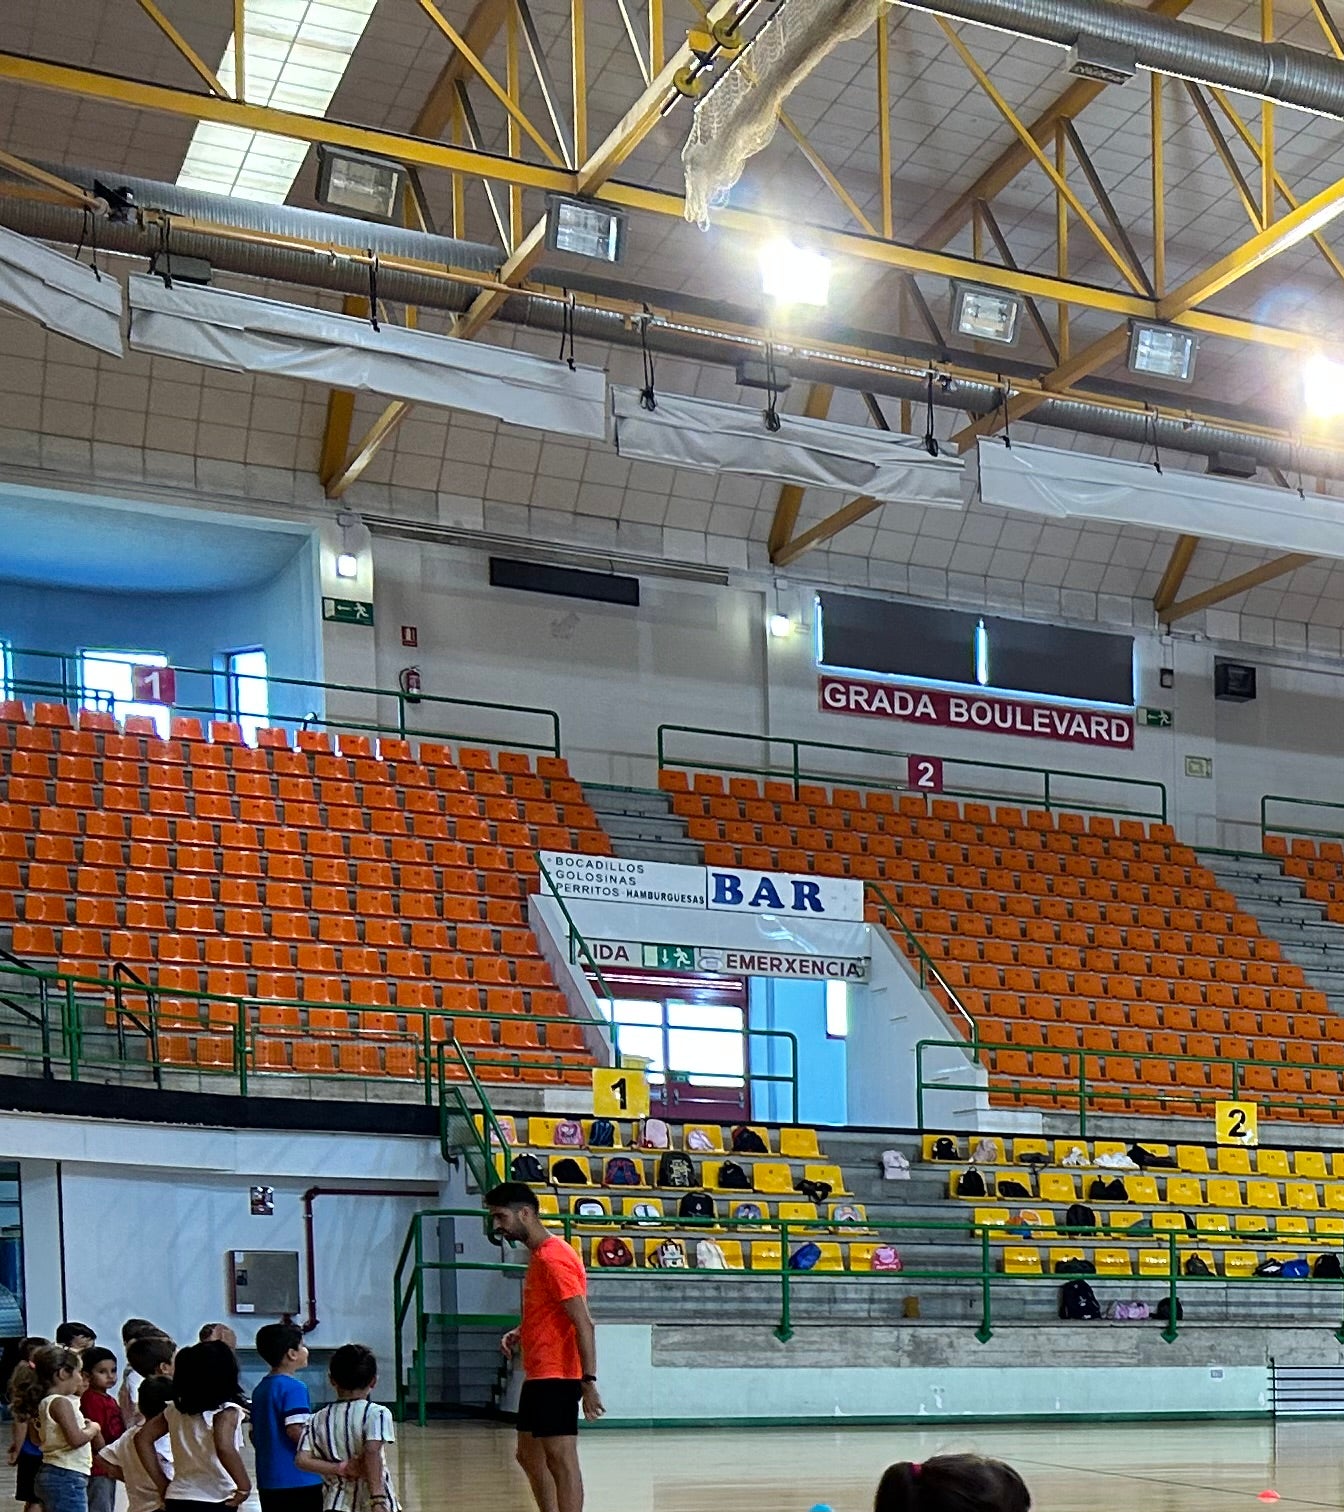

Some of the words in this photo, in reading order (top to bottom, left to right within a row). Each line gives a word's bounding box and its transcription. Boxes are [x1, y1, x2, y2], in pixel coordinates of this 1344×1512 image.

[144, 671, 160, 700] 1
[823, 682, 937, 719] GRADA
[949, 697, 1130, 742] BOULEVARD
[917, 762, 934, 787] 2
[555, 856, 645, 874] BOCADILLOS
[555, 869, 637, 886] GOLOSINAS
[555, 883, 620, 897] PERRITOS
[626, 890, 705, 905] HAMBURGUESAS
[711, 872, 825, 913] BAR
[726, 954, 859, 978] EMERXENCIA
[610, 1077, 627, 1110] 1
[1228, 1109, 1247, 1137] 2
